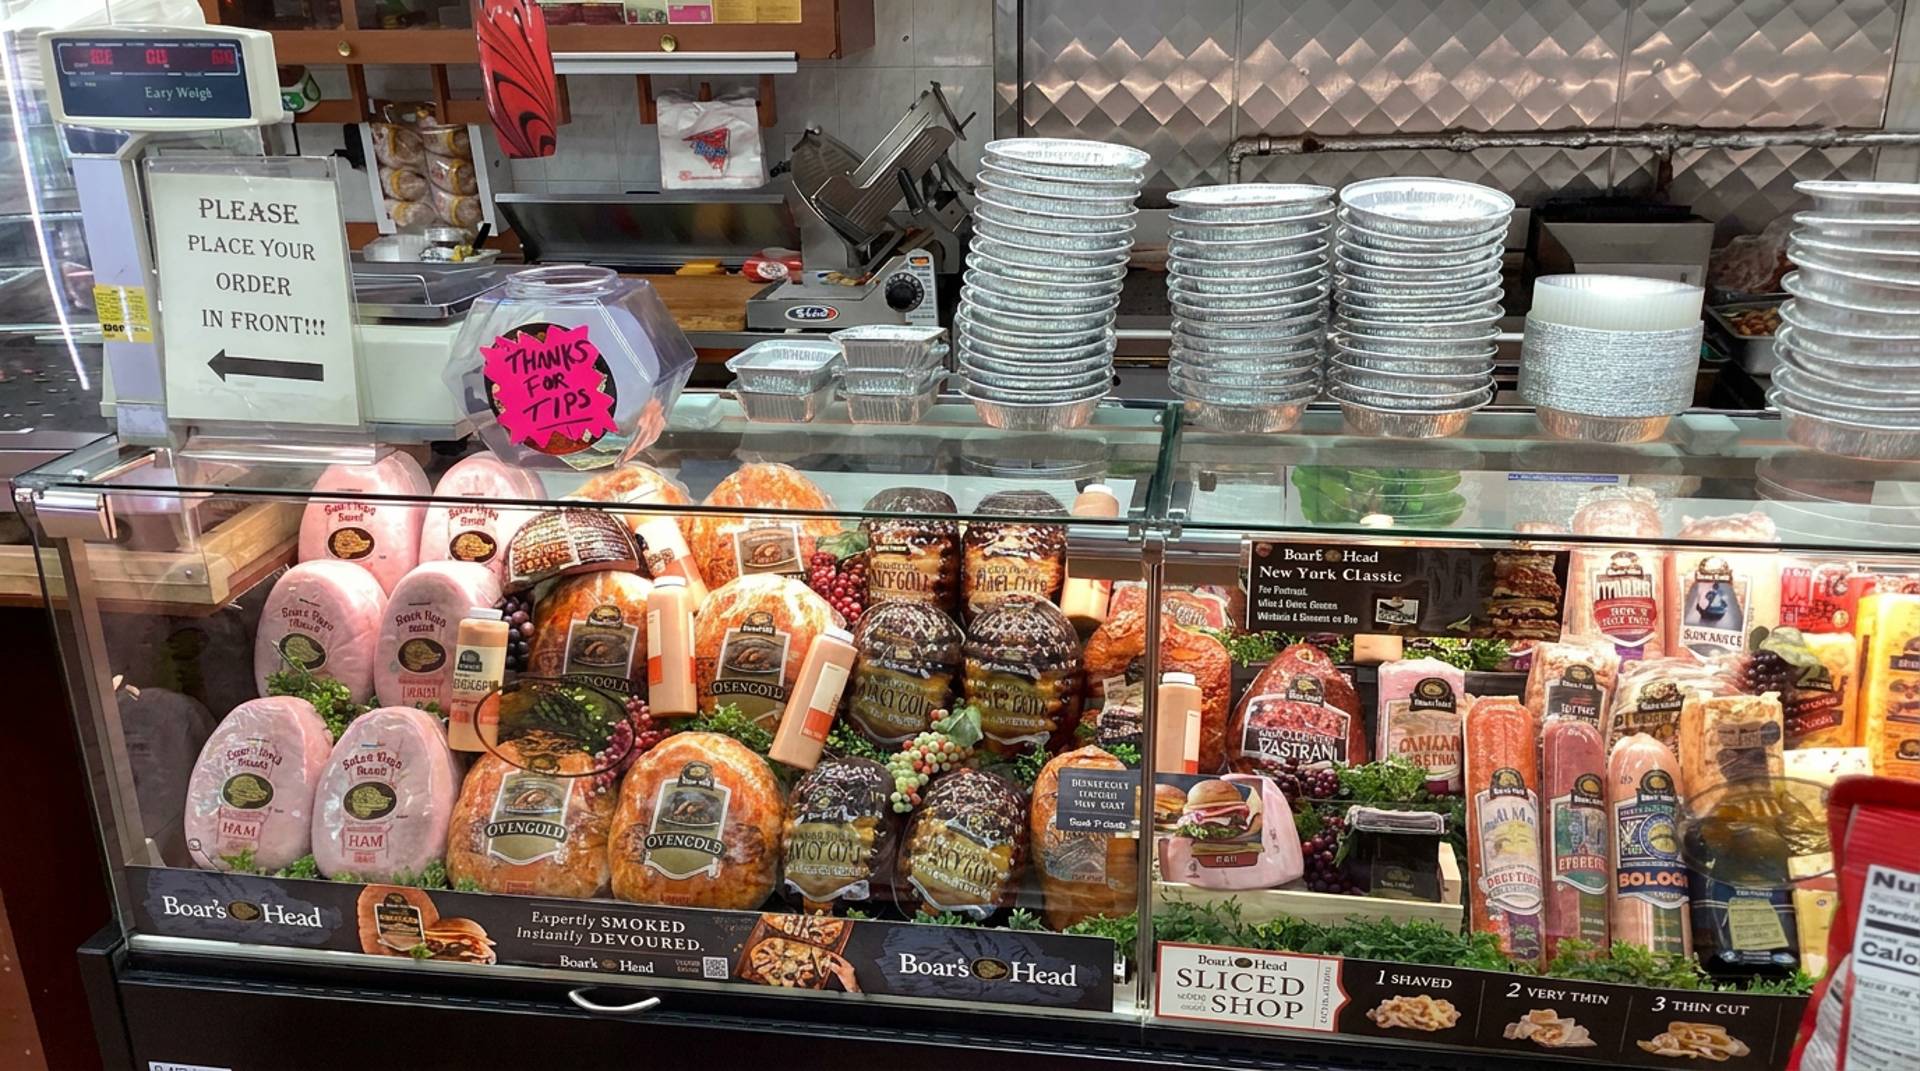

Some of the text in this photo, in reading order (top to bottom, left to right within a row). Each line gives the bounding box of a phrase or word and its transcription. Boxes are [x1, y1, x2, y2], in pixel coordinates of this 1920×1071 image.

[198, 197, 300, 225] PLEASE
[187, 234, 316, 262] PLACE YOUR
[215, 272, 292, 297] ORDER
[201, 309, 326, 337] IN FRONT!!!
[504, 339, 591, 374] THANKS
[522, 372, 570, 398] FOR
[522, 388, 592, 422] TIPS
[1259, 565, 1293, 578] New
[1342, 568, 1402, 582] Classic
[348, 835, 383, 847] HAM
[162, 895, 323, 928] Boar's Head
[531, 911, 686, 933] Expertly SMOKED
[516, 926, 705, 952] Instantly DEVOURED.
[898, 952, 1077, 987] Boar's Head
[1254, 959, 1288, 972] Head
[1176, 967, 1305, 997] SLICED
[1375, 969, 1452, 989] 1 SHAVED
[1506, 982, 1609, 1005] 2 VERY THIN
[1651, 996, 1750, 1016] 3 THIN CUT
[1210, 994, 1304, 1020] SHOP
